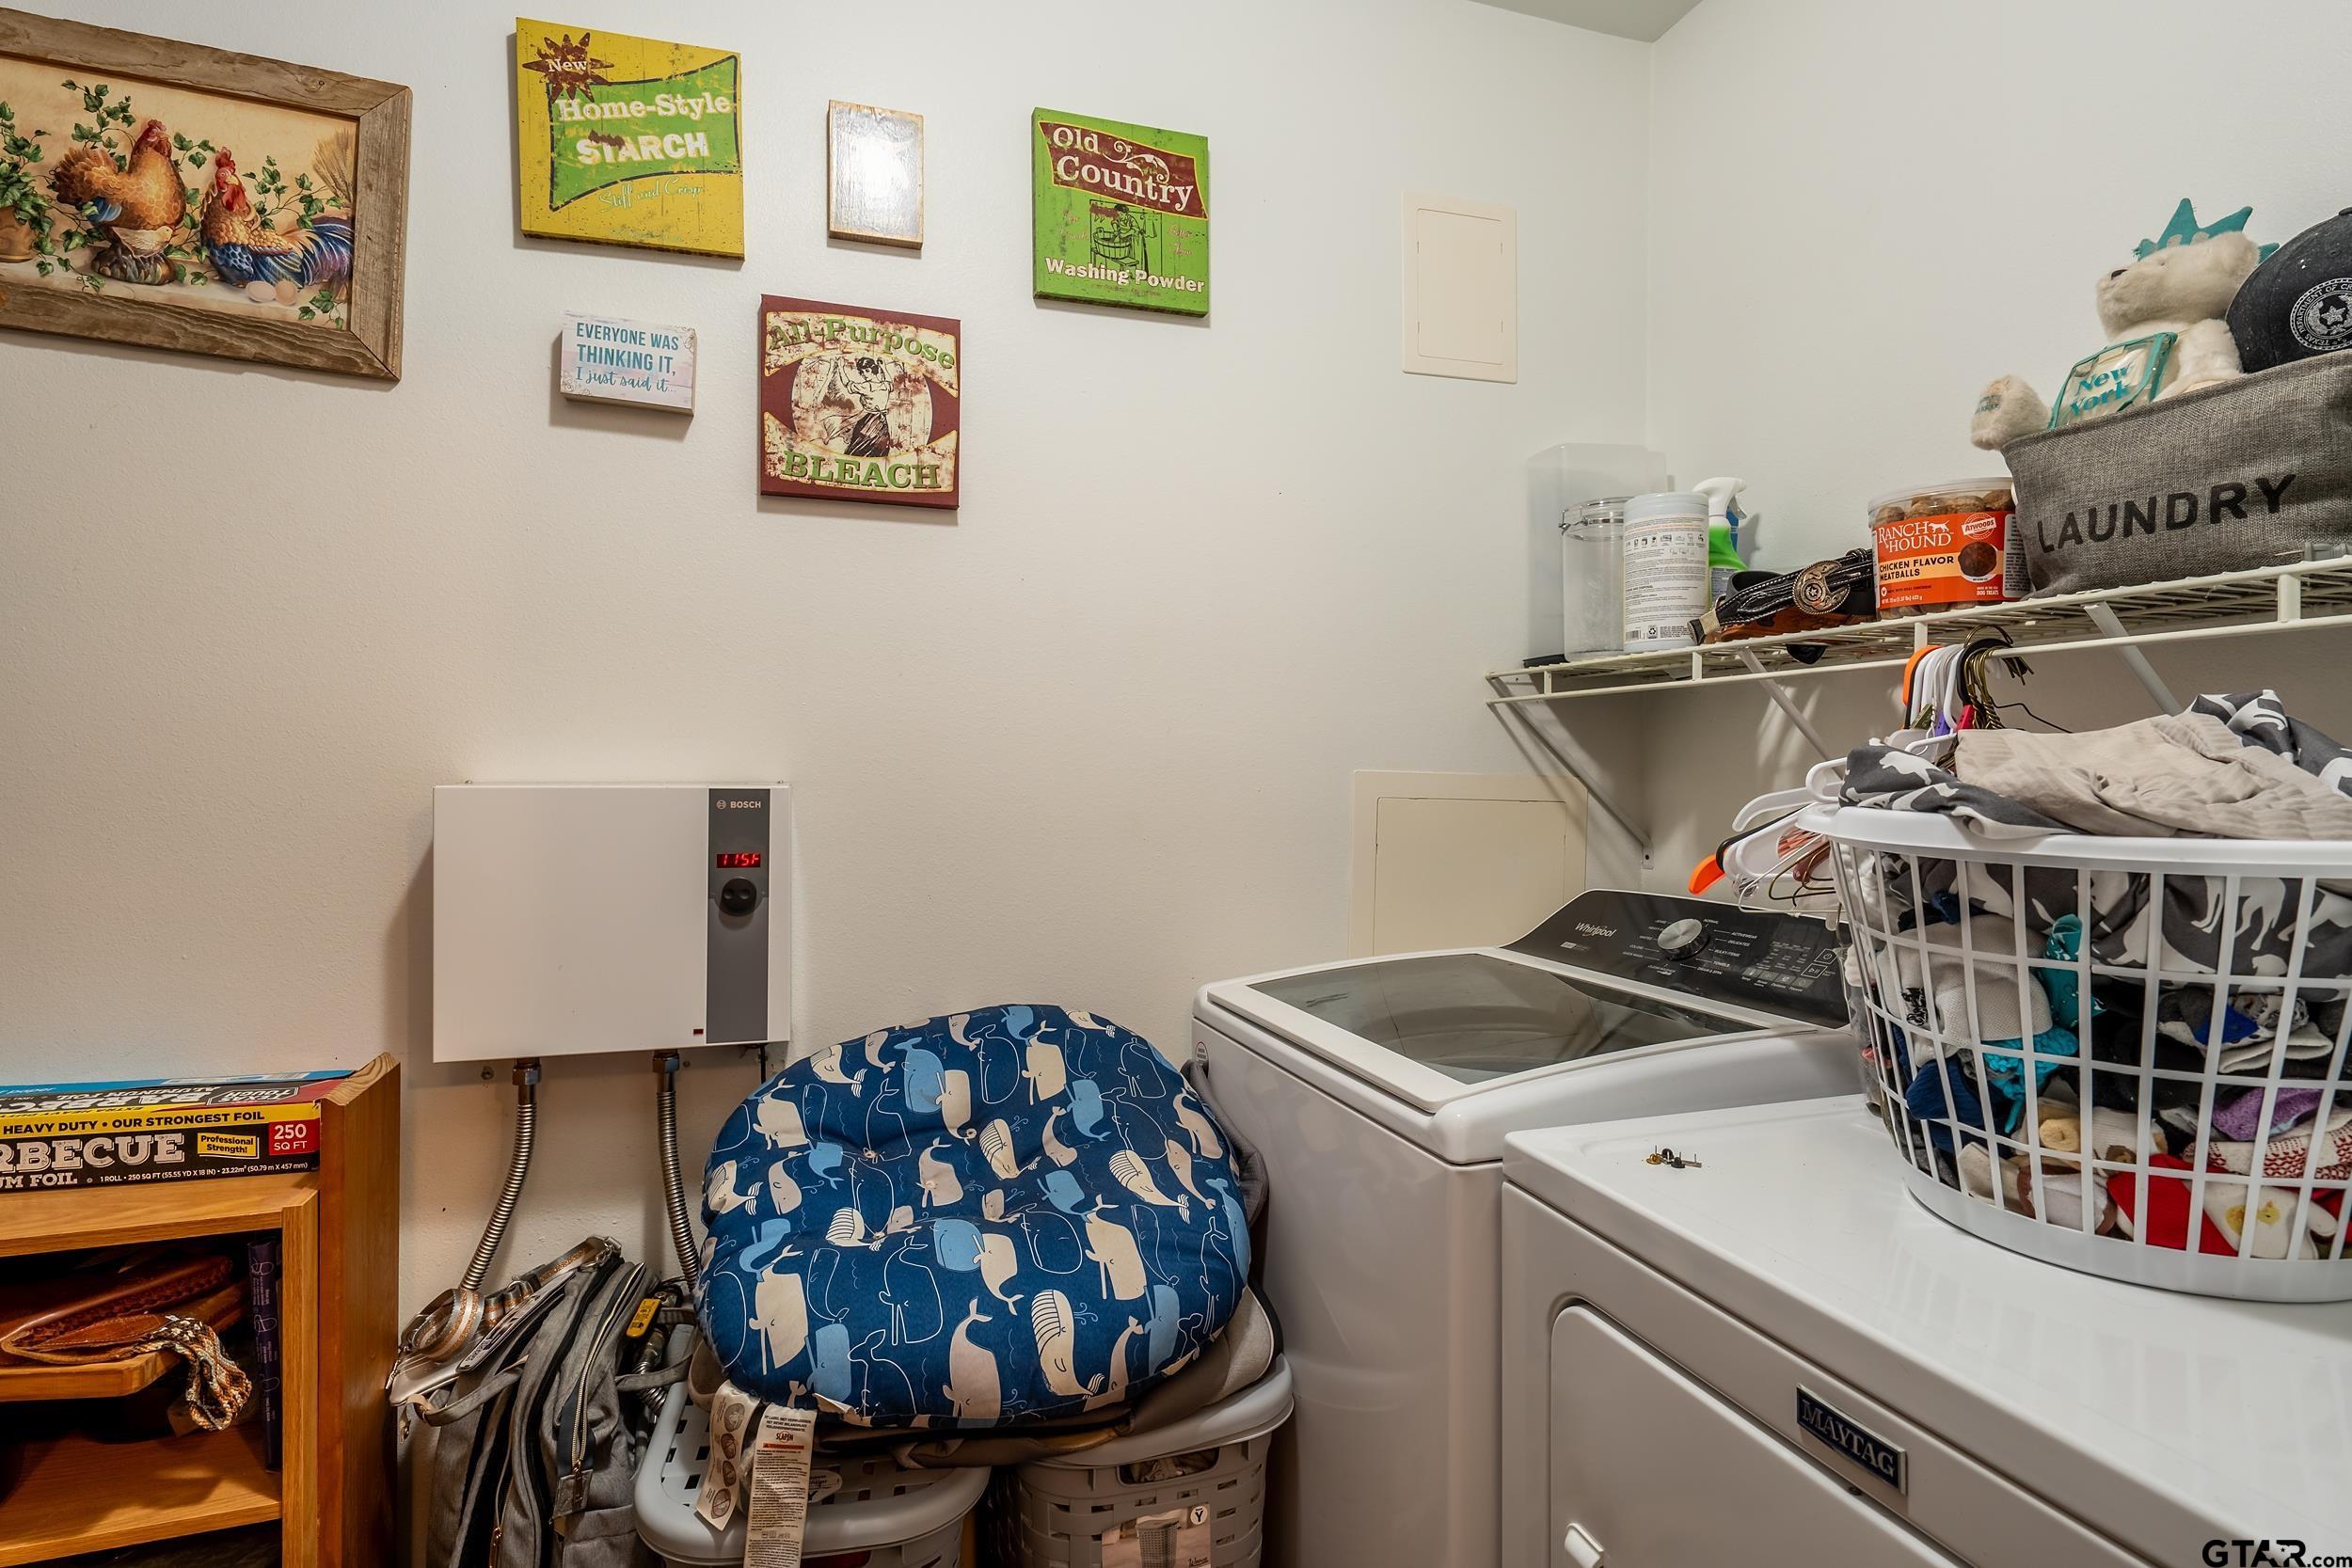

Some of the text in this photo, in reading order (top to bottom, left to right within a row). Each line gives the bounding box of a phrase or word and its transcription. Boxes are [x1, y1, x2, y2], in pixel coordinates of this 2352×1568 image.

[547, 59, 587, 71] New
[558, 92, 730, 121] Home-Style
[576, 132, 709, 165] STARCH
[1053, 127, 1102, 154] Old
[1057, 155, 1194, 212] Country
[1045, 257, 1129, 286] Washing
[1135, 269, 1205, 293] Powder
[577, 322, 679, 351] EVERYONE WAS
[577, 344, 676, 376] THINKING IT,
[576, 366, 583, 380] I
[585, 369, 617, 386] just
[620, 376, 652, 391] said
[782, 450, 942, 489] BLEACH
[2037, 473, 2297, 554] LAUNDRY
[1879, 520, 1930, 545] RANCH
[1885, 532, 1952, 553] HOUND
[1880, 555, 1954, 573] CHICKEN FLAVOR
[730, 800, 761, 809] BOSCH
[1575, 922, 1617, 937] Whirlpool
[3, 1111, 264, 1134] HEAVY DUTY OUR STRONGEST FOIL
[274, 1123, 307, 1140] 250
[200, 1134, 253, 1145] Professional
[206, 1144, 247, 1153] Strength!
[274, 1140, 308, 1150] SQ FT
[30, 1172, 77, 1187] FOIL
[1801, 1399, 1895, 1478] MAYTAG
